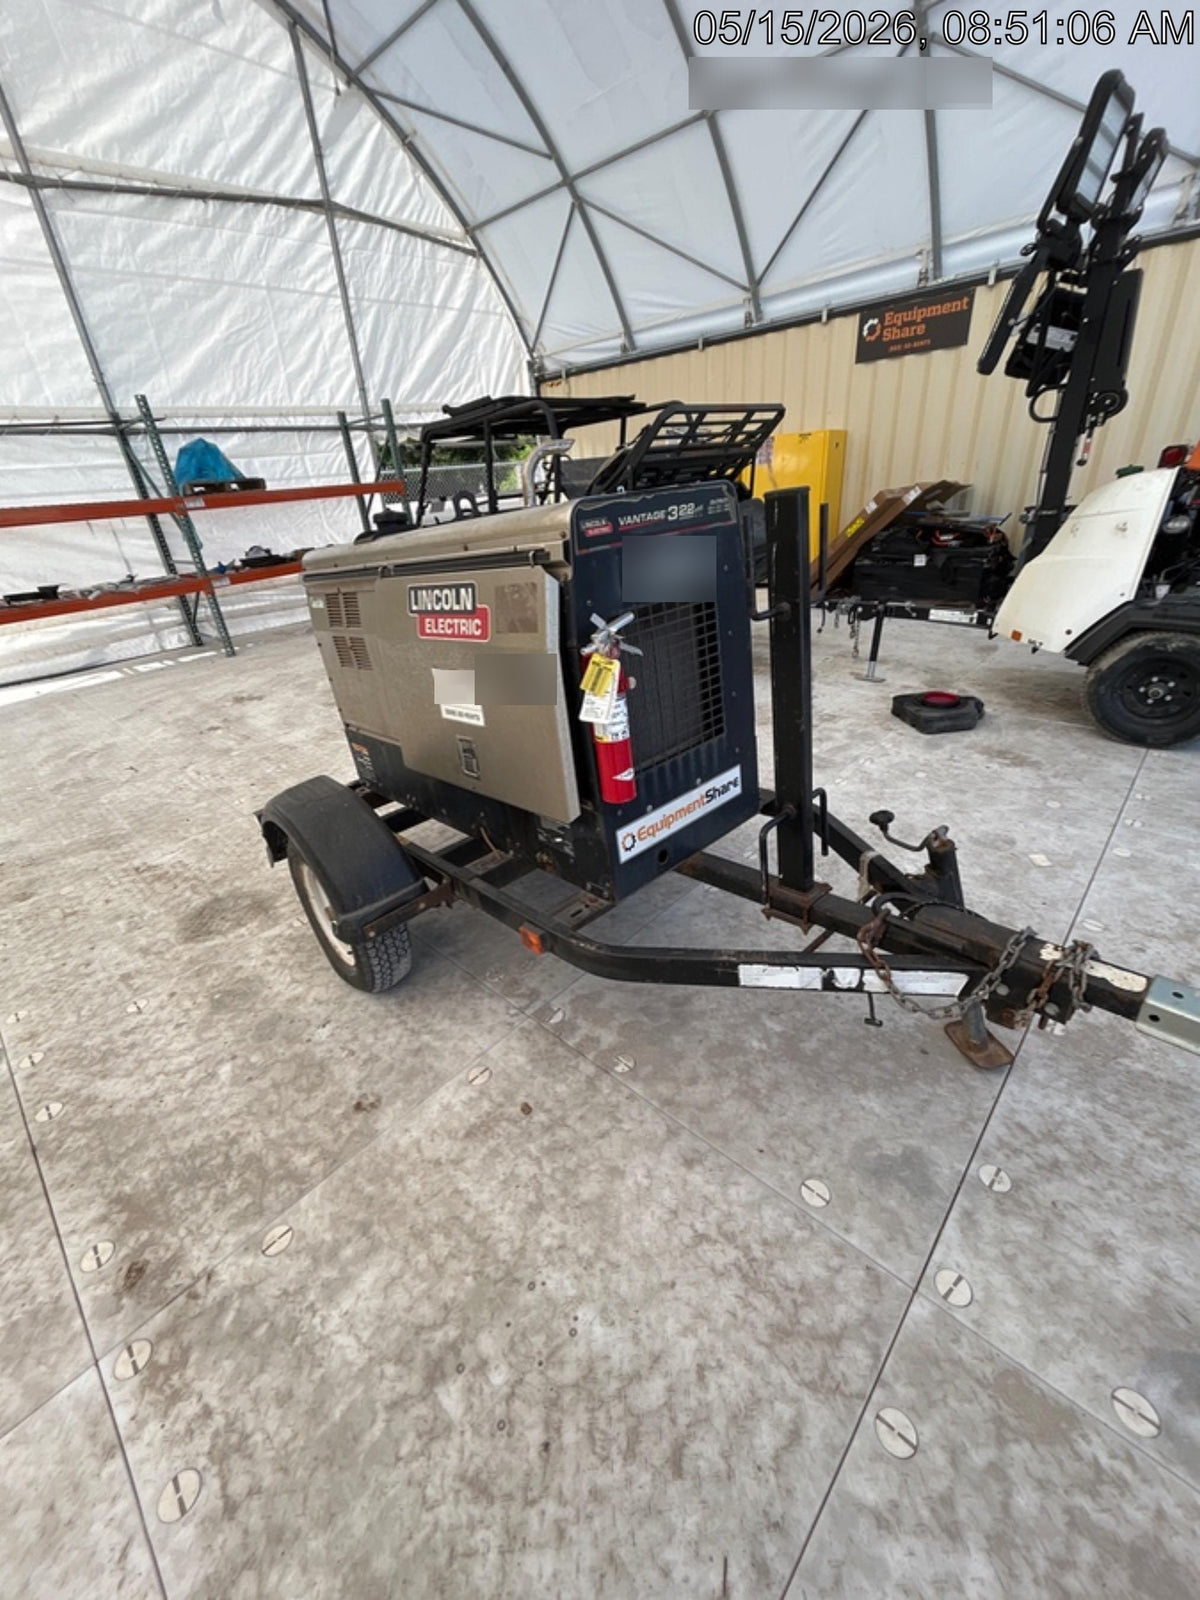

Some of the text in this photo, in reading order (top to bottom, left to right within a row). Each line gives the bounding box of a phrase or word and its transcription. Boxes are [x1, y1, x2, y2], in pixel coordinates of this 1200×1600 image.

[884, 296, 969, 327] Equipment
[881, 323, 926, 342] Share
[617, 508, 667, 526] VANTAGE
[410, 587, 473, 611] LINCOLN
[424, 617, 482, 636] ELECTRIC
[637, 776, 739, 842] EquipmentShare
